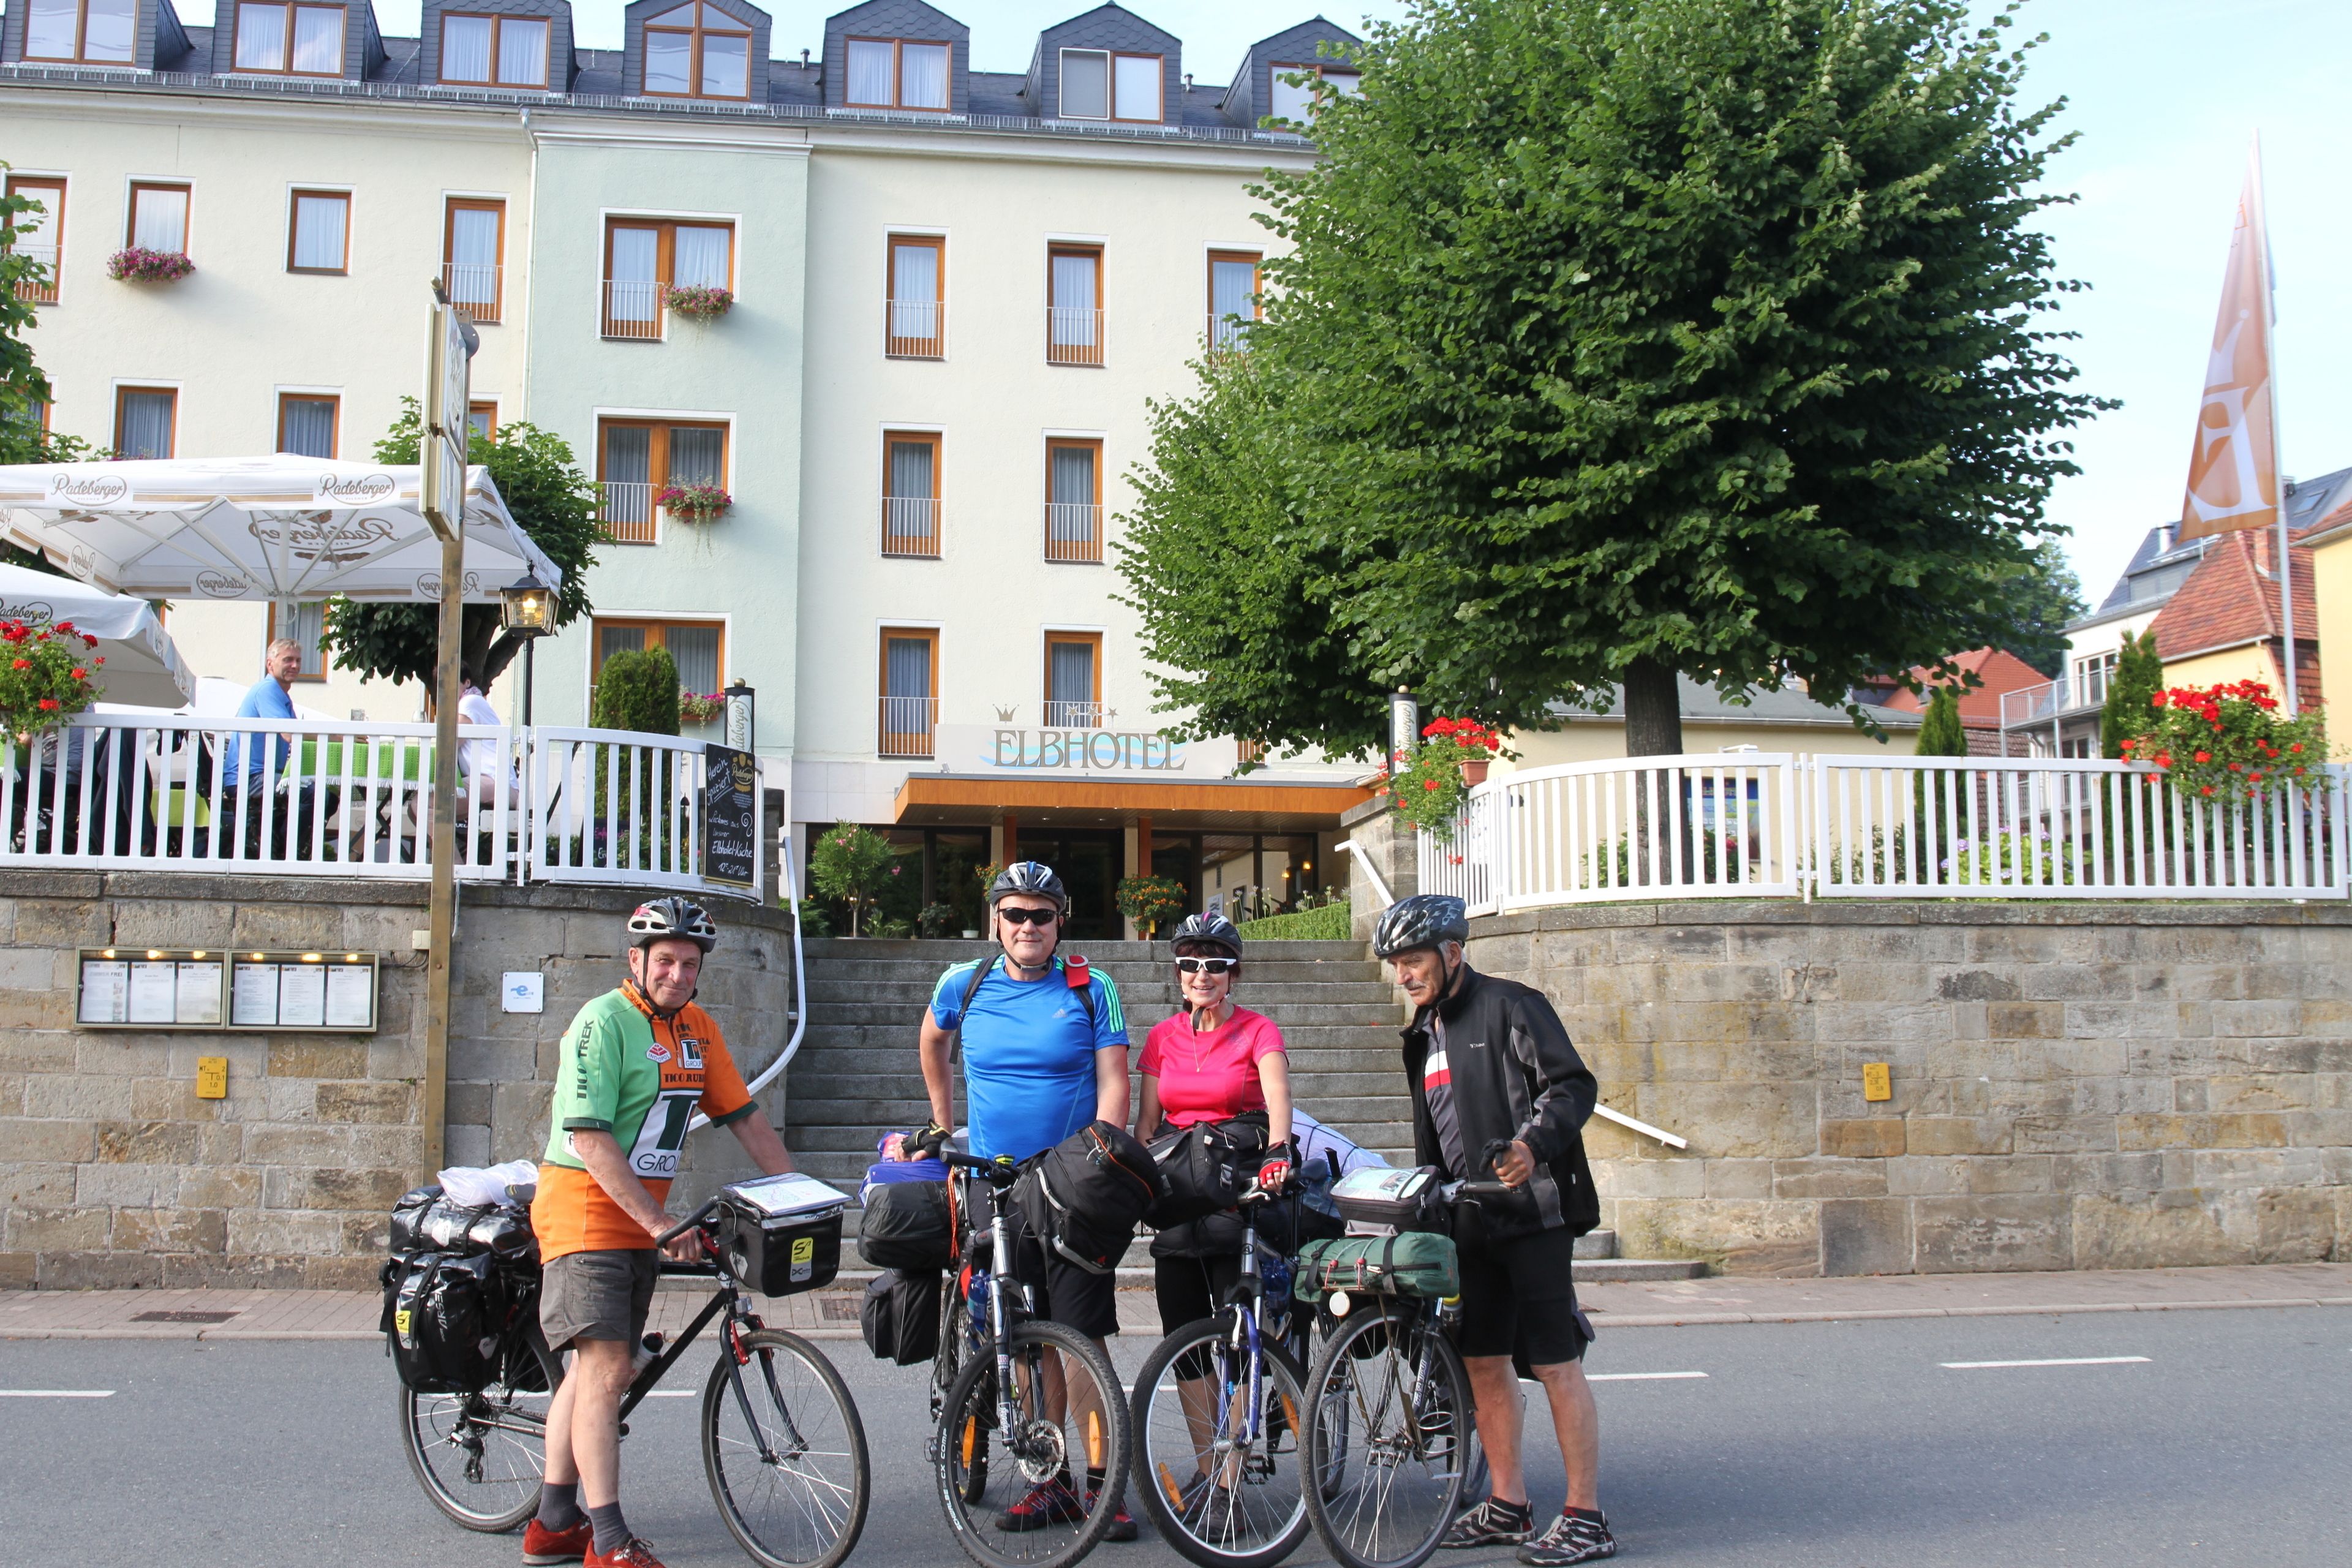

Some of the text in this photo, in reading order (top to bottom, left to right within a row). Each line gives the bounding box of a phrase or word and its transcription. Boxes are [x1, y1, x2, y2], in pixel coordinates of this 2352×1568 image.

[51, 473, 126, 500] Radeberger
[319, 473, 393, 499] Radeberger
[0, 598, 50, 623] adeberger
[993, 729, 1186, 771] ELBHOTEL
[578, 1019, 594, 1059] TREK
[941, 1464, 946, 1479] CX
[943, 1489, 963, 1531] SCHWALBE
